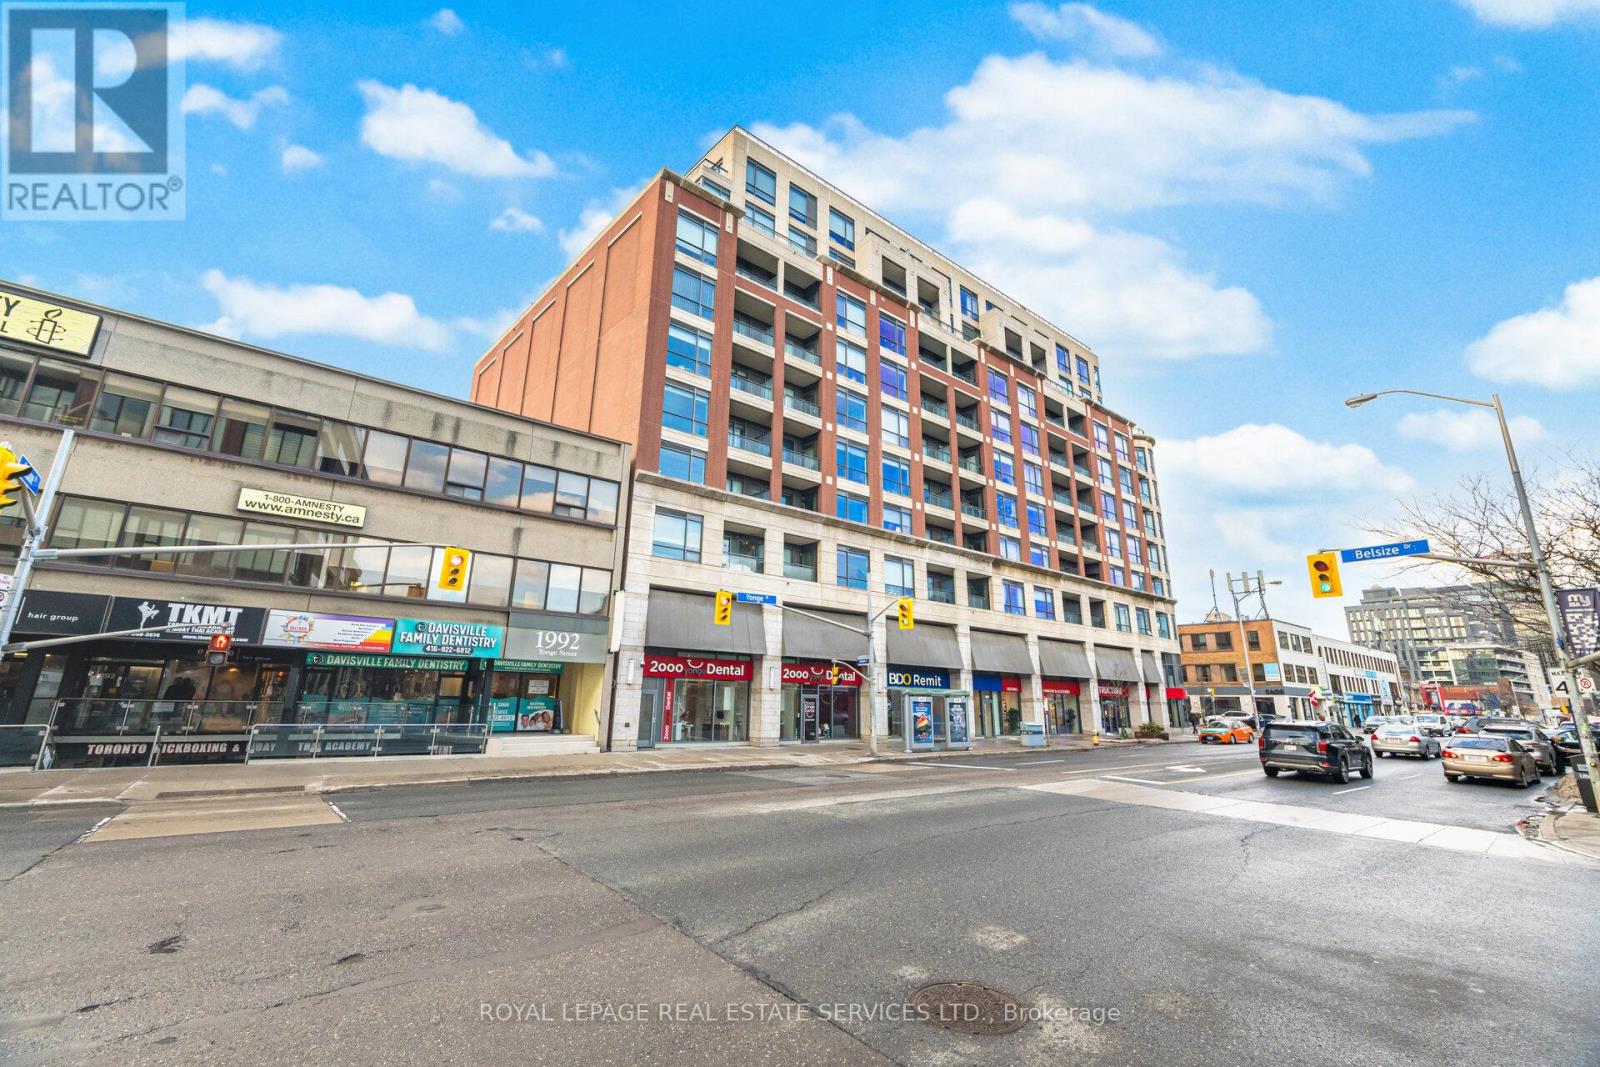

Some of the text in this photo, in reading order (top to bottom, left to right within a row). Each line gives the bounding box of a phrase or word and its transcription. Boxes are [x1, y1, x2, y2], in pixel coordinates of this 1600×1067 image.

[264, 494, 345, 513] 1-800-AMNESTY
[245, 500, 360, 524] www.amnesty.ca
[1355, 546, 1400, 559] Belsize
[746, 593, 764, 603] Yonge
[50, 614, 79, 622] group
[168, 603, 243, 626] TKMT
[428, 623, 487, 637] DAVISVILLE
[400, 632, 497, 648] FAMILY DENTISTRY
[536, 631, 580, 650] 1992
[539, 647, 558, 657] Yonge
[326, 655, 465, 671] DAVISVILLE FAMILY DENTISTRY
[650, 660, 683, 673] 2000
[706, 663, 745, 676] Dental
[783, 668, 809, 679] 2000
[826, 670, 856, 681] Dntal
[889, 672, 942, 687] BDO Remit
[88, 744, 147, 755] TORONTO
[232, 744, 240, 752] &
[325, 741, 372, 751] ACADEMY
